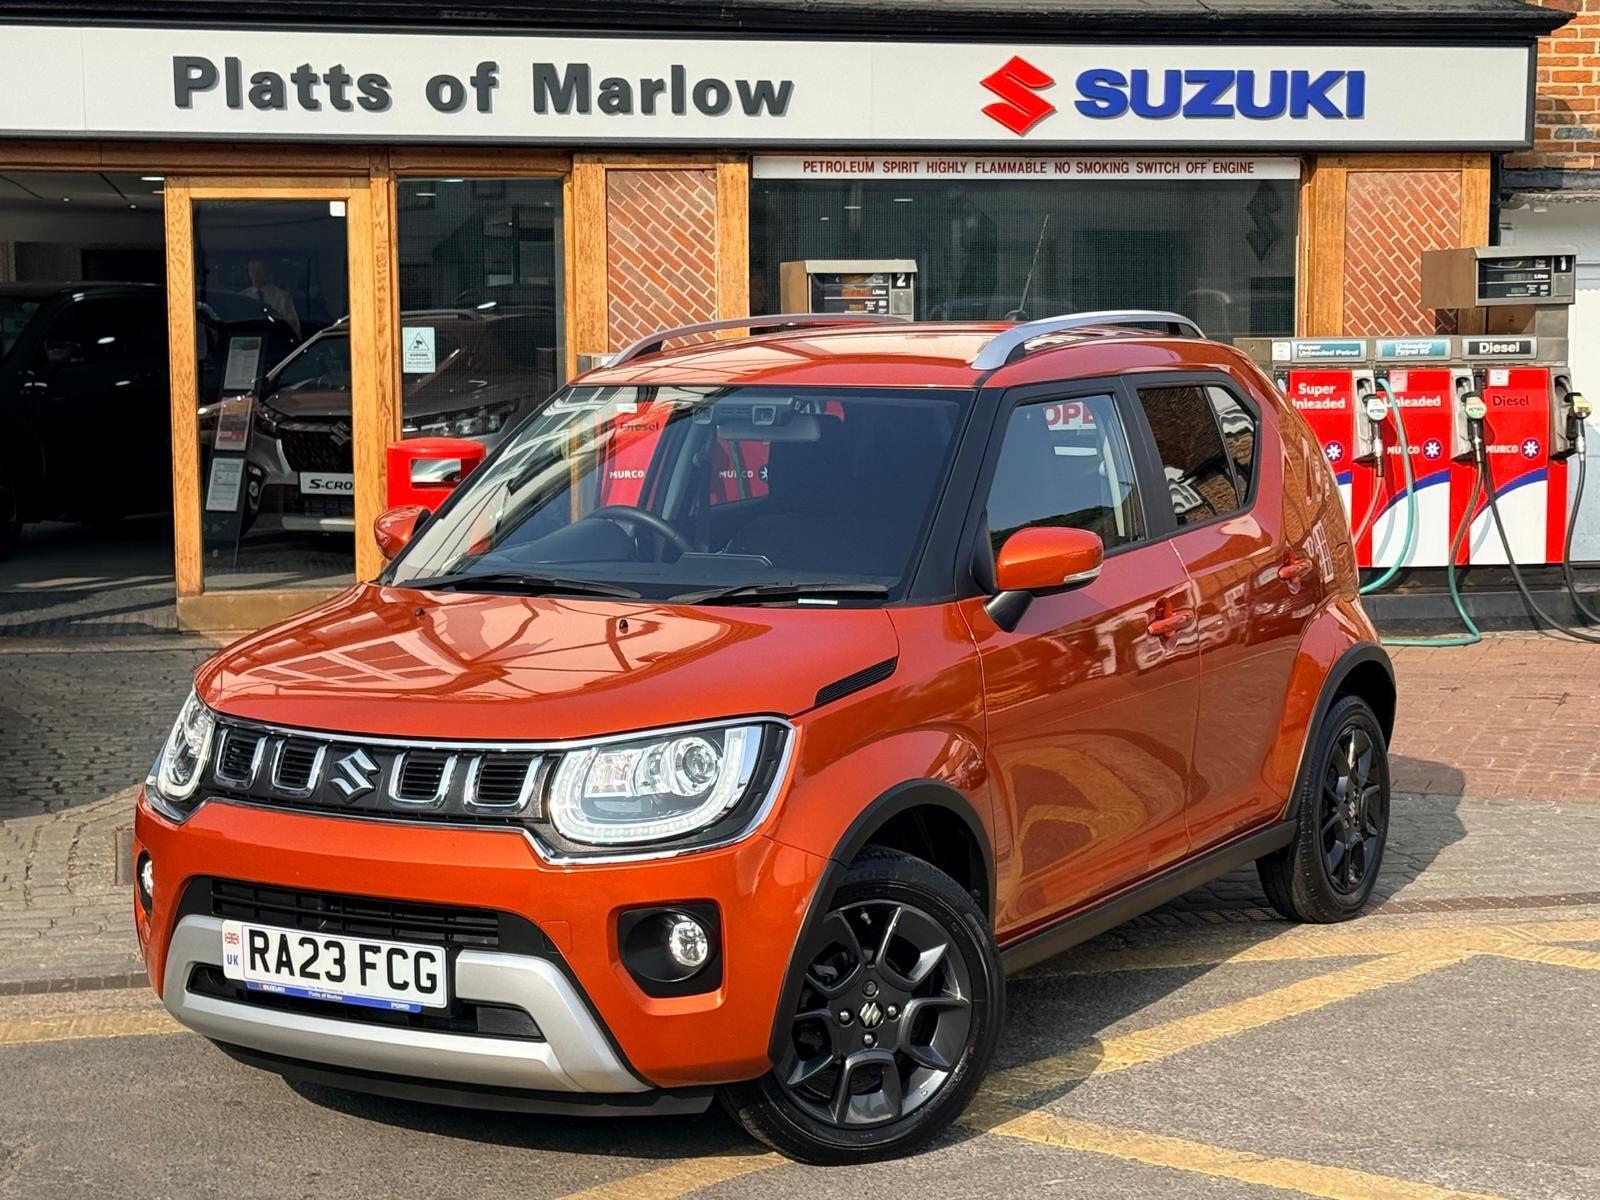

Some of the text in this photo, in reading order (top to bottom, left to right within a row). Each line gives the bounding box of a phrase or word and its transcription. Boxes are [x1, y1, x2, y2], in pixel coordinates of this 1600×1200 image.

[173, 56, 793, 116] Platts of Marlow
[1074, 68, 1365, 119] SUZUKI
[803, 160, 1254, 174] PETROLEUM SPIRIT HIGHLY FLAMMABLE NO SMOKING SWITCH OFF ENGINE
[1560, 256, 1567, 271] 1
[896, 272, 906, 287] 2
[1479, 342, 1520, 354] Diesel
[1298, 383, 1336, 397] Super
[1492, 395, 1529, 406] Diesel
[1387, 445, 1420, 455] MUCO
[1485, 444, 1519, 454] MURCO
[609, 469, 645, 479] MURCO
[226, 953, 239, 966] UK
[248, 928, 437, 994] RA23 FCG
